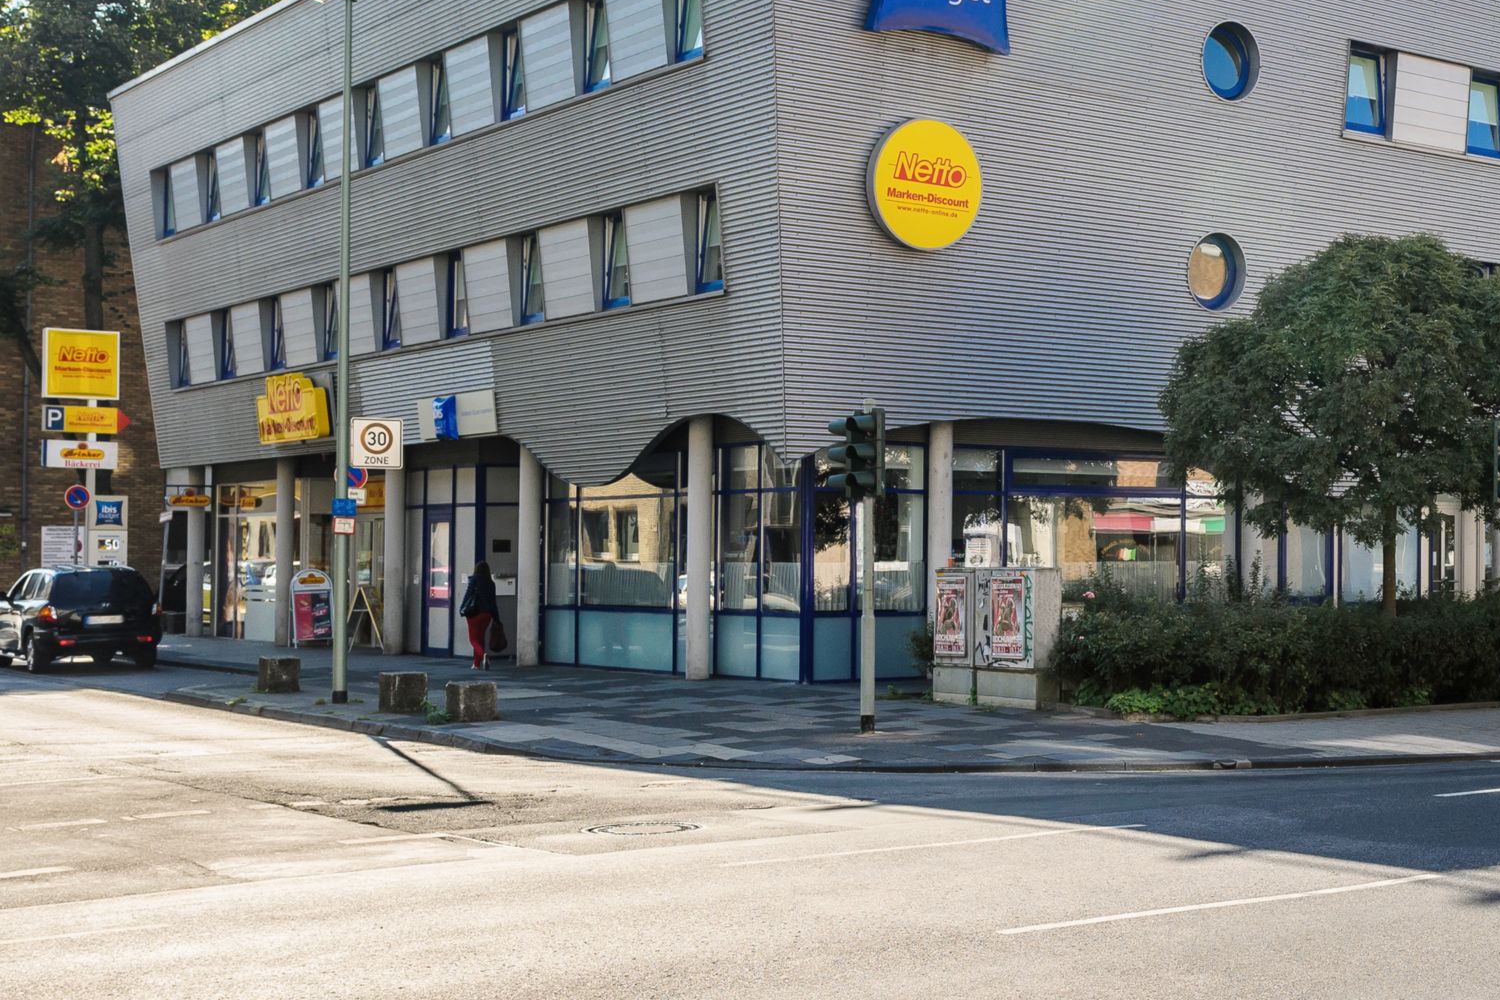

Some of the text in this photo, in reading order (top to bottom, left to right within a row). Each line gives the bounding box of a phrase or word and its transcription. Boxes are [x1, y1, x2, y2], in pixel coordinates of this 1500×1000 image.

[893, 151, 967, 189] Netto
[887, 187, 969, 209] Marken-Discount
[896, 205, 958, 218] www.netto-online.de
[58, 346, 110, 363] Netto
[267, 375, 302, 414] Netto
[47, 409, 62, 428] P
[367, 431, 387, 446] 30
[64, 460, 101, 469] Bäckerei
[364, 456, 389, 465] ZONE
[101, 504, 118, 514] ibis
[104, 539, 120, 551] 50
